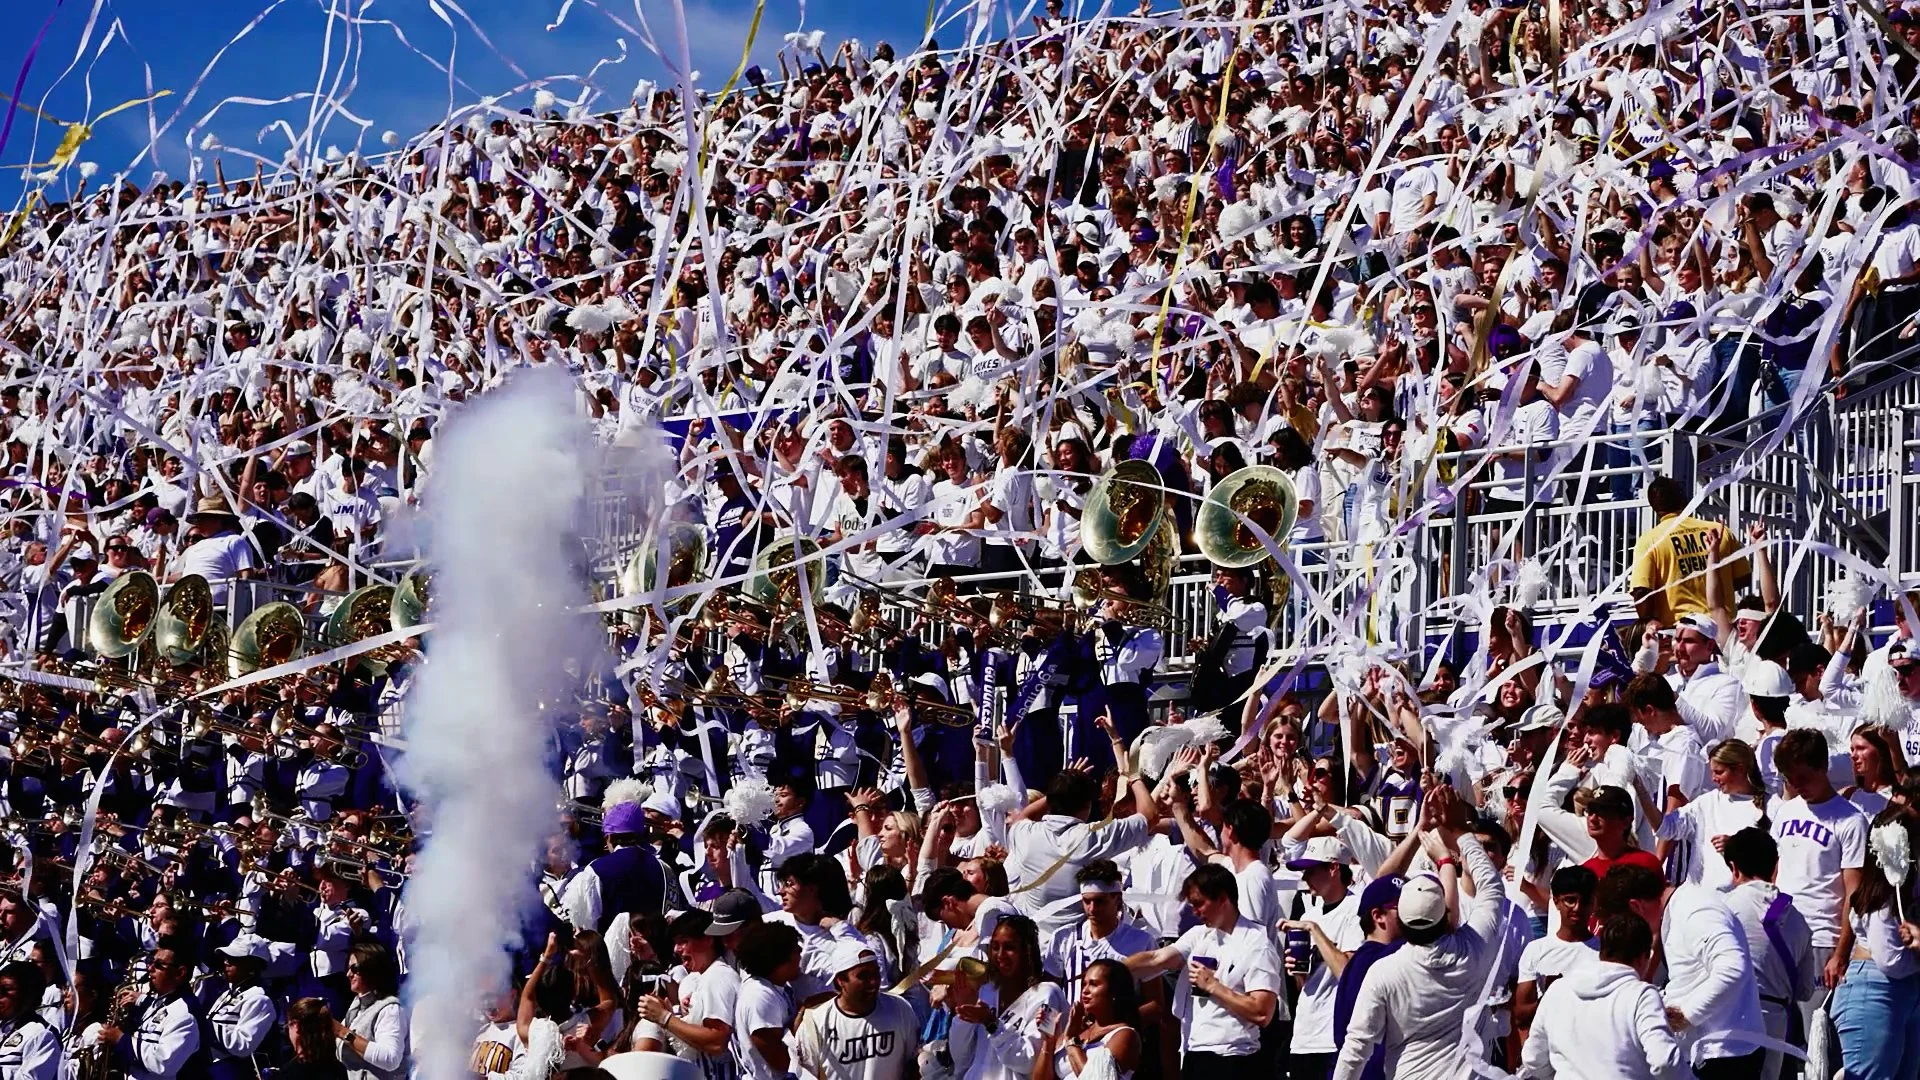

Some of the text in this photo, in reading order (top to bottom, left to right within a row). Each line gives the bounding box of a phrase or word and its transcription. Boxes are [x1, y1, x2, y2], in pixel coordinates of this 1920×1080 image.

[1678, 555, 1708, 576] EVEN
[984, 666, 996, 683] GO
[1779, 819, 1834, 848] JMU
[839, 1030, 895, 1065] JMU
